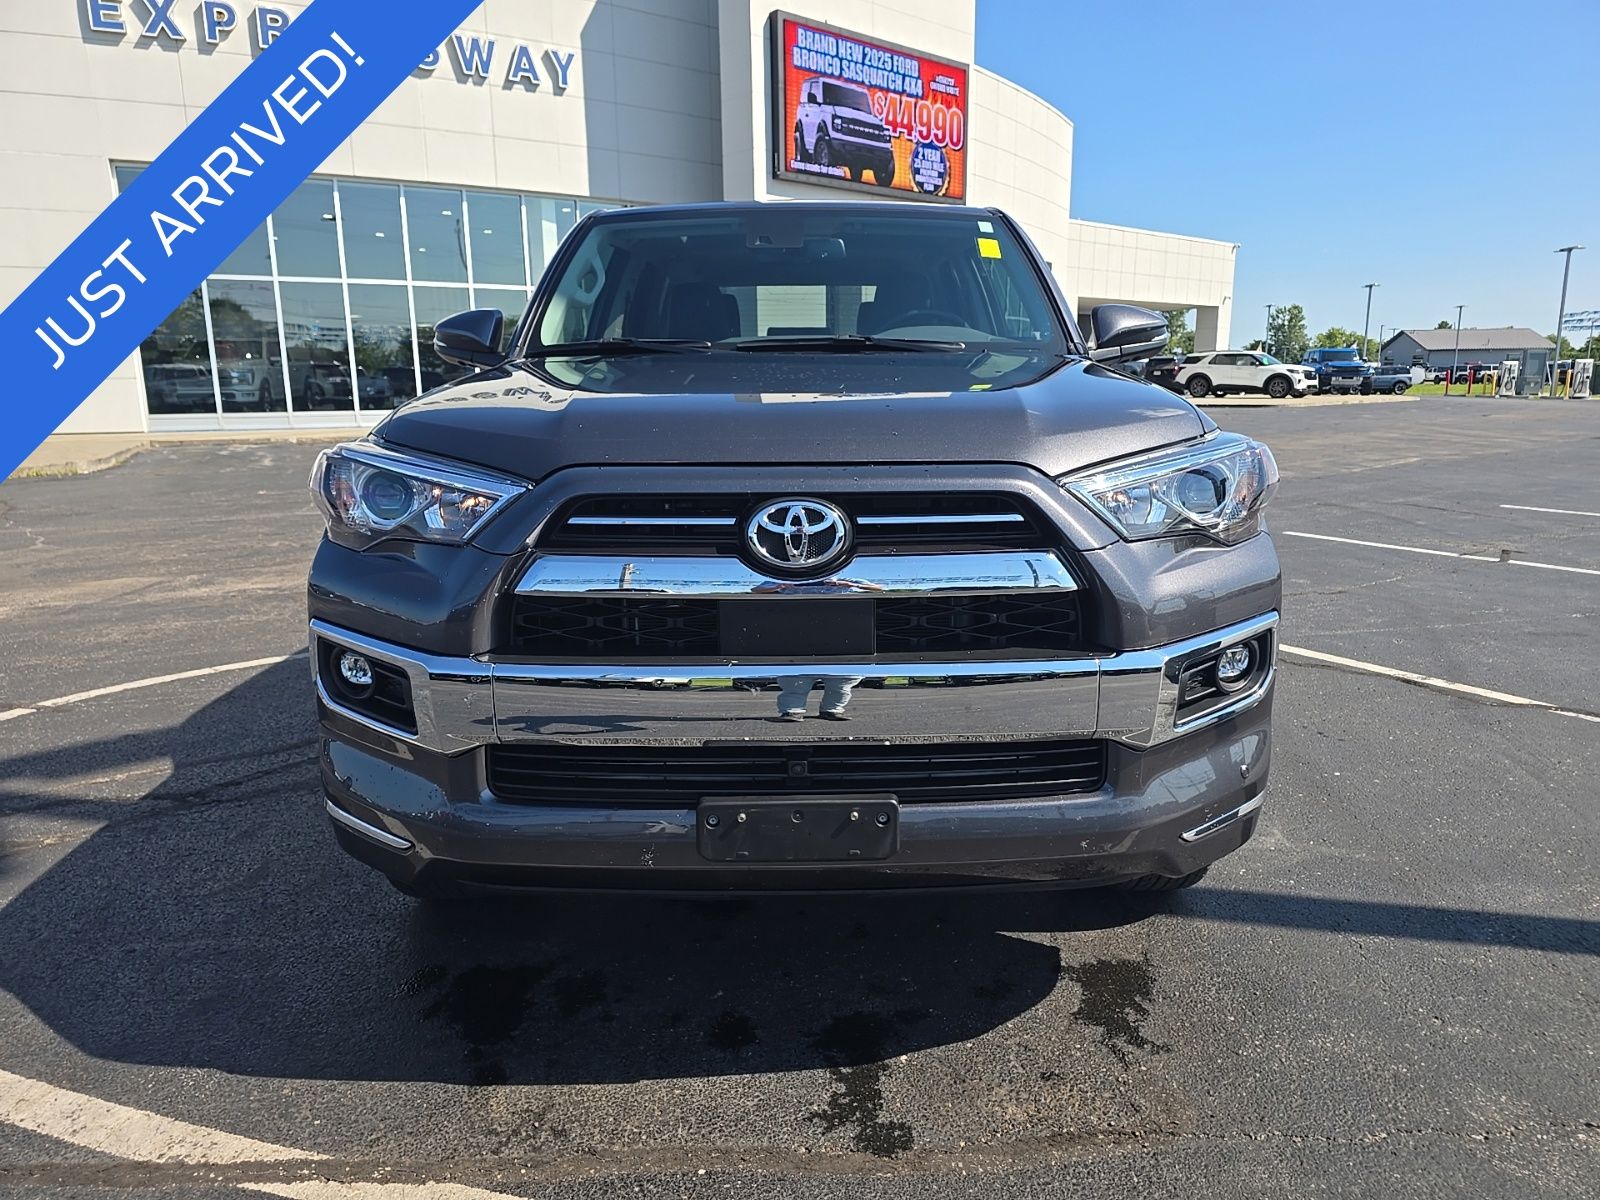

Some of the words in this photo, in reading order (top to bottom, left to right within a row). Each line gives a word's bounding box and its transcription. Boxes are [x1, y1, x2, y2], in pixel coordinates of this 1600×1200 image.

[87, 0, 575, 88] EXPRWAY
[797, 27, 837, 56] BRAND
[838, 38, 863, 63] NEW
[864, 46, 892, 71] 2025
[893, 54, 919, 78] FORD
[792, 46, 841, 76] BRONCO
[841, 59, 903, 92] SASQUATCH
[904, 76, 923, 97] 4X4
[917, 147, 924, 160] 2
[924, 148, 941, 163] YEAR
